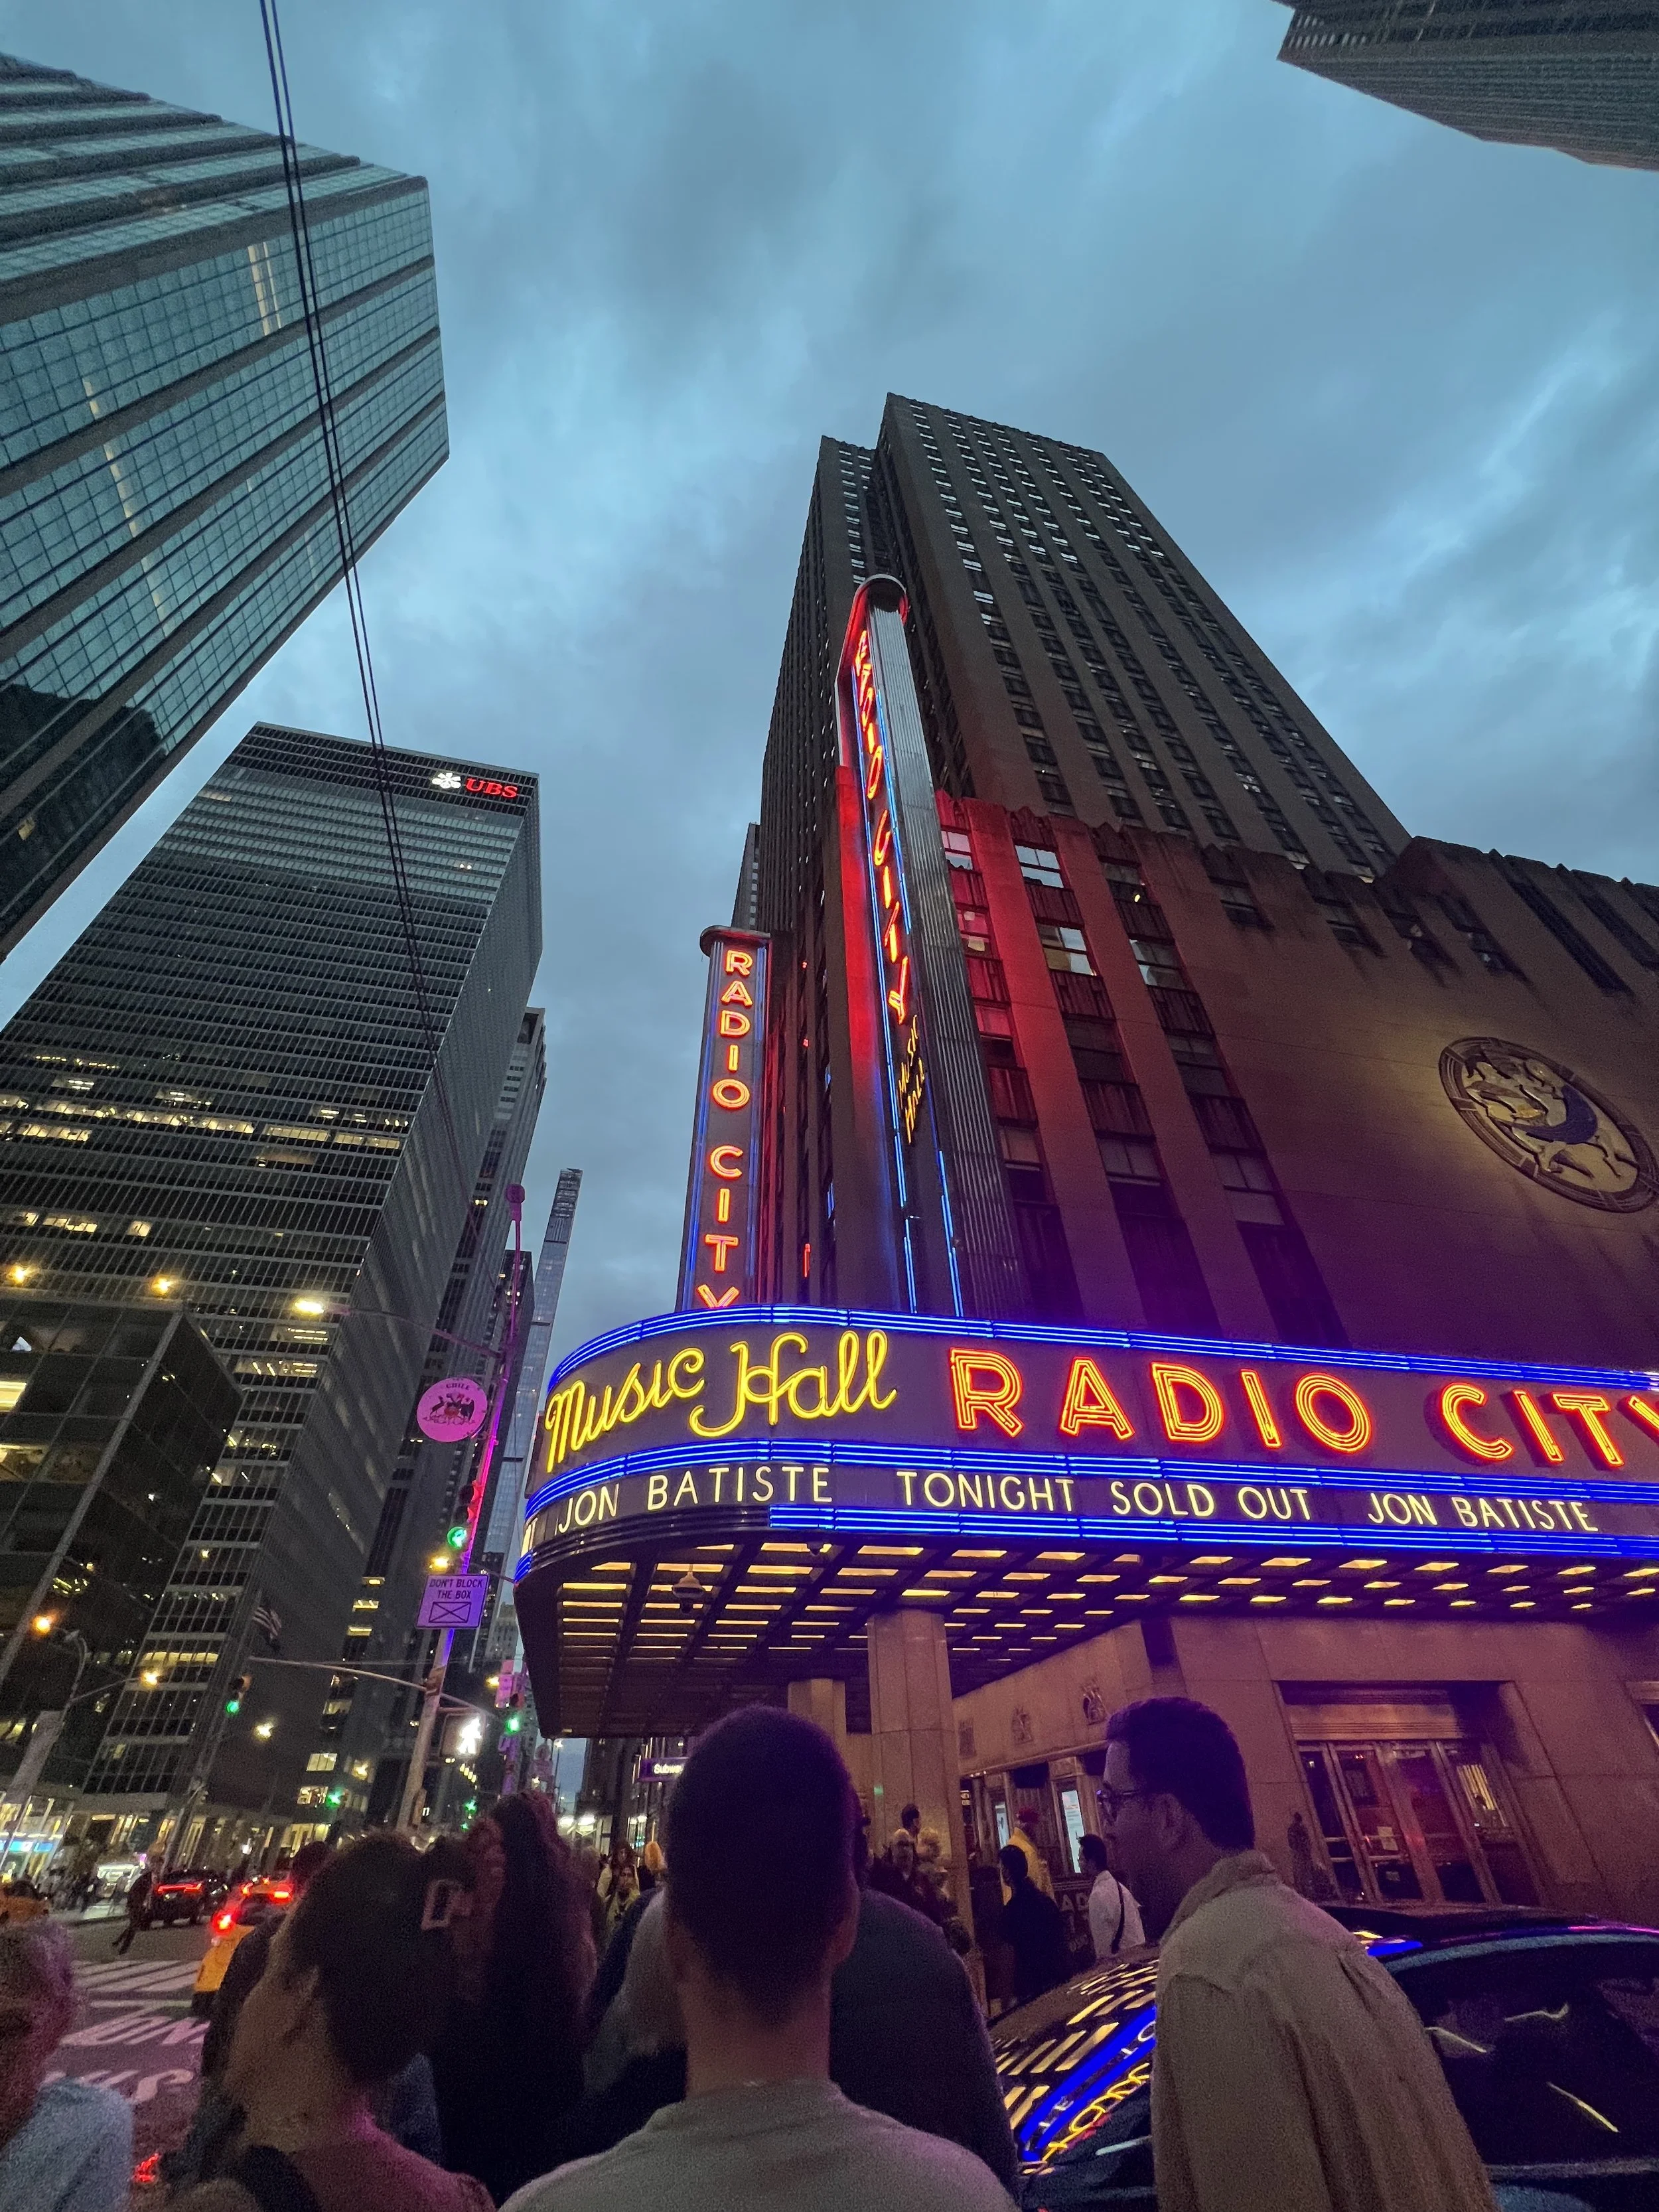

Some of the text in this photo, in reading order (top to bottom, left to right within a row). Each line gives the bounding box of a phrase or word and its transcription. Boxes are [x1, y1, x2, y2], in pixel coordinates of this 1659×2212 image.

[466, 778, 518, 798] UBS
[712, 949, 753, 1110] RADIO
[545, 1347, 705, 1473] Music
[689, 1329, 897, 1438] Hall
[948, 1346, 1373, 1455] RADIO
[558, 1465, 1598, 1533] JON BATISTE TONIGHT SOLD OUT JON BATISTE
[429, 1579, 483, 1588] DON'T BLOCK
[437, 1590, 472, 1599] THE BOX
